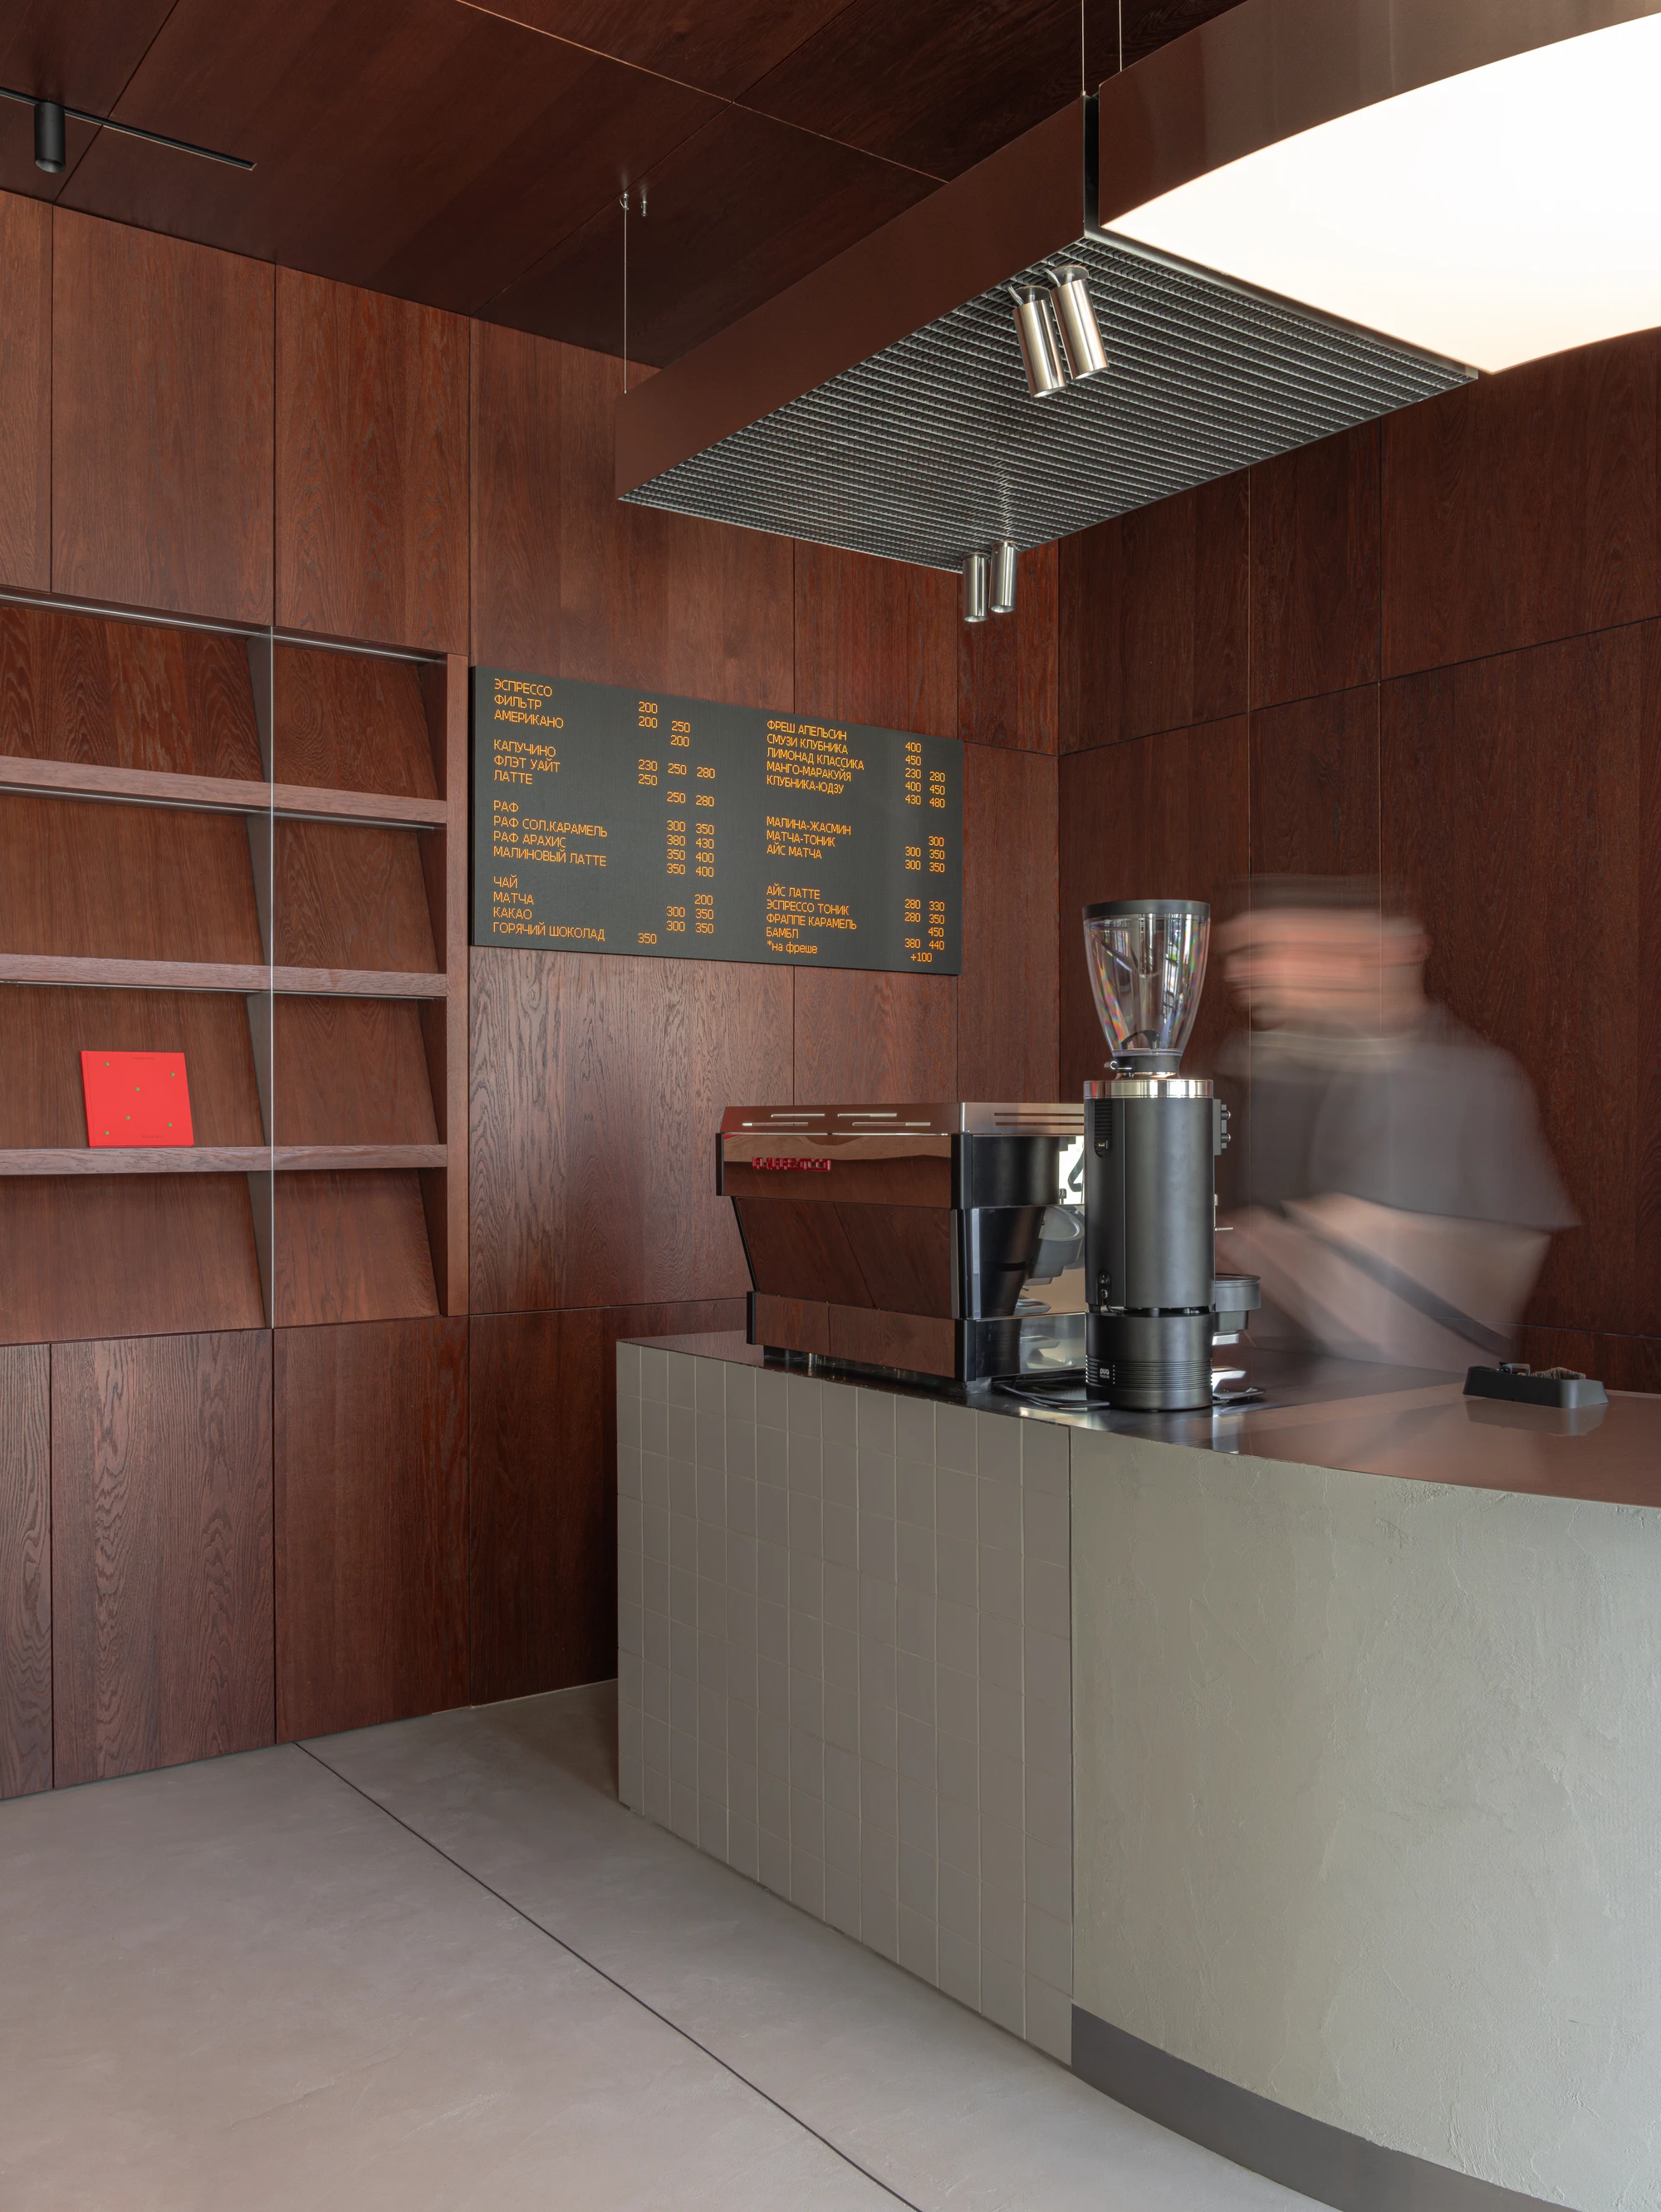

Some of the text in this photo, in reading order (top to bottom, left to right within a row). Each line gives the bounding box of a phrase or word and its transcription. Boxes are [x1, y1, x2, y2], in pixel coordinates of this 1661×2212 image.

[494, 678, 659, 714] ЭСПРЕССО 200
[494, 693, 691, 733] ФИЛЬТР 200 250
[494, 709, 690, 748] АМЕРИКАНО 200
[767, 719, 922, 753] ФРЕШ АПЕЛЬСИН 400
[767, 733, 922, 767] СМУЗИ КЛУБНИКА 450
[493, 739, 716, 779] КАПУЧИНО 230 250 280
[493, 754, 659, 787] ФЛЭТ УАЙТ 250
[767, 747, 946, 782] ЛИМОНАД КЛАССИКА 230 280
[493, 770, 715, 807] ЛАТТЕ 250 280
[767, 761, 946, 796] МАНГО-МАРАКУЙЯ 400 450
[767, 775, 946, 808] КЛУБНИКА-ЮДЗУ 430 480
[493, 801, 714, 836] РАФ 300 350
[493, 815, 519, 828] РАФ
[666, 835, 686, 846] 380
[695, 837, 714, 850] 430
[767, 817, 944, 847] МАЛИНА-ЖАСМИН 300
[493, 831, 714, 864] РАФ АРАХИС 350 400
[493, 846, 714, 878] МАЛИНОВЫЙ ЛАТТЕ 350 400
[767, 830, 945, 861] МАТЧА-ТОНИК 300 350
[767, 842, 945, 873] АЙС МАТЧА 300 350
[493, 875, 713, 905] ЧАЙ 200
[493, 891, 714, 920] МАТЧА 300 350
[767, 883, 945, 912] АЙС ЛАТТЕ 280 330
[493, 907, 714, 934] КАКАО 300 350
[766, 913, 944, 938] ФРАППЕ КАРАМЕЛЬ 450
[767, 900, 945, 925] ЭСПРЕССО ТОНИК 280 350
[492, 921, 657, 944] ГОРЯЧИЙ ШОКОЛАД 350
[766, 927, 945, 950] БАМБЛ 380 440
[786, 942, 818, 954] фреше
[910, 952, 933, 963] +100
